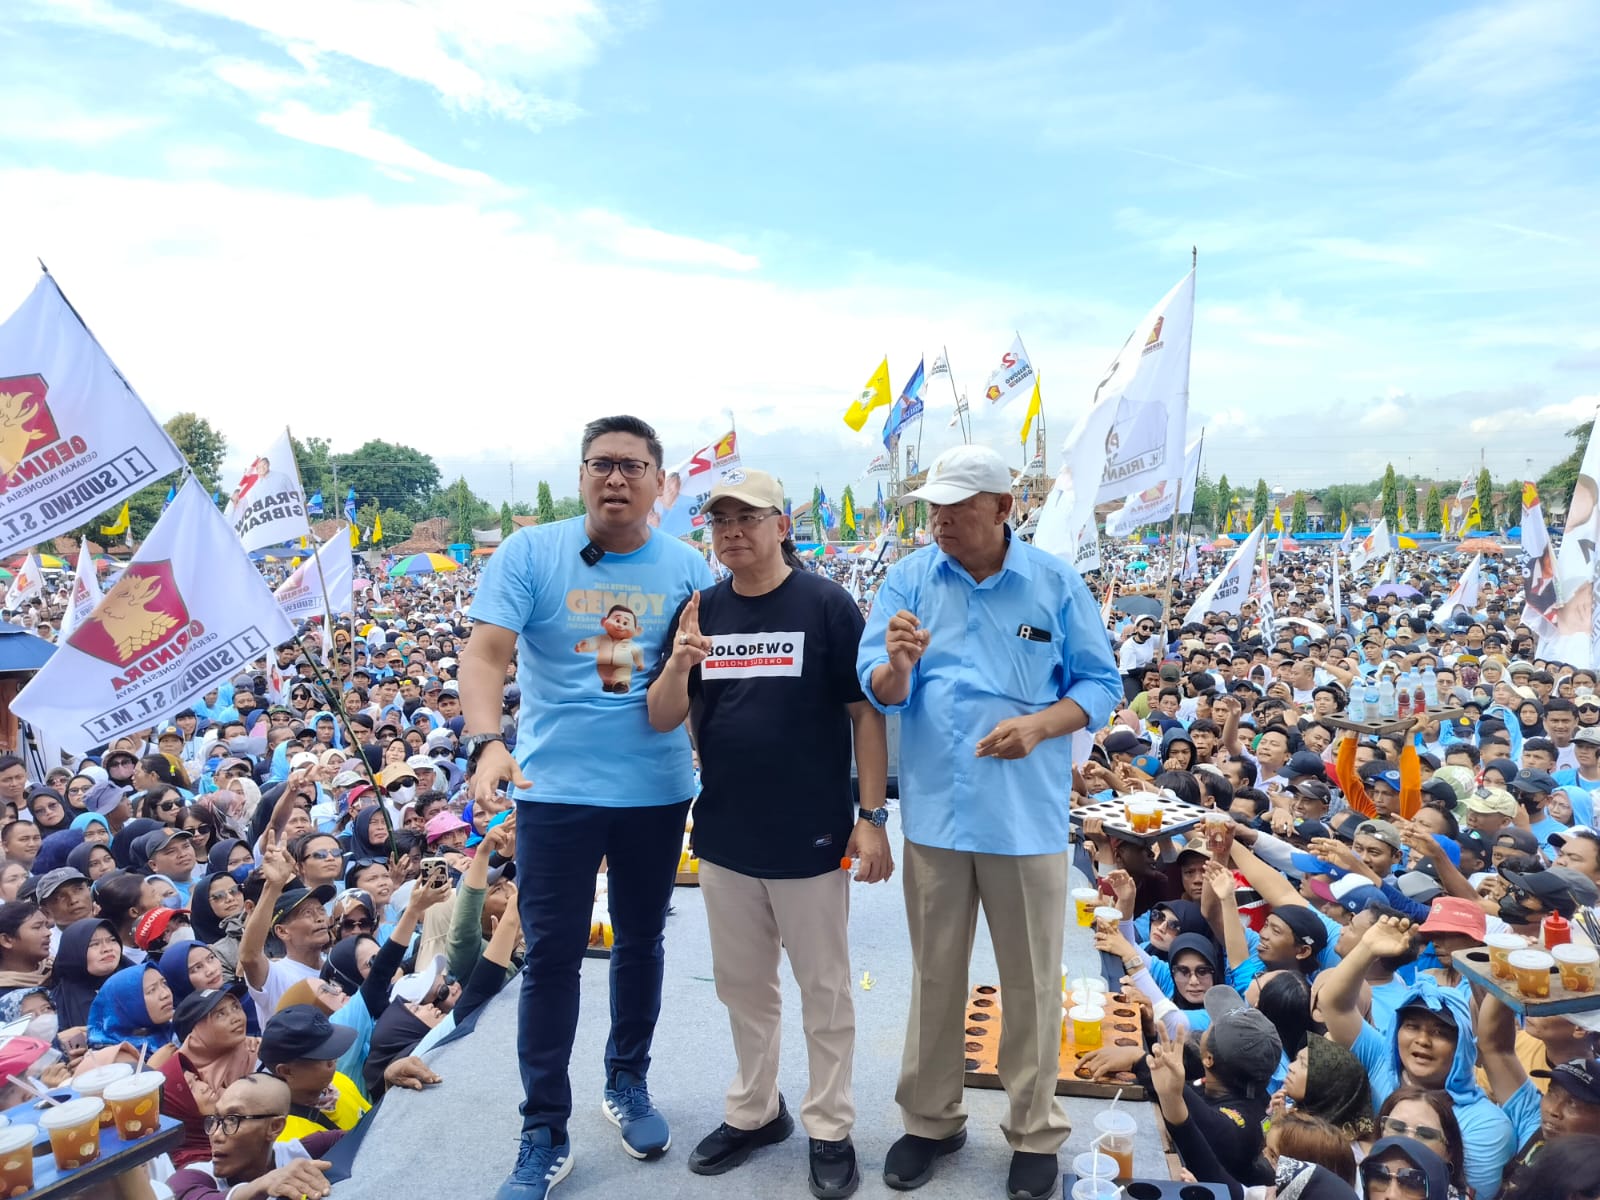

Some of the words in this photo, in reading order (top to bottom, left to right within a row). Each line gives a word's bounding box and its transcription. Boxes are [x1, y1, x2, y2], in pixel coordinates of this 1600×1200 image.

[566, 589, 666, 616] GEMOY
[714, 659, 748, 668] BOLONE
[749, 657, 783, 667] SUDEWO
